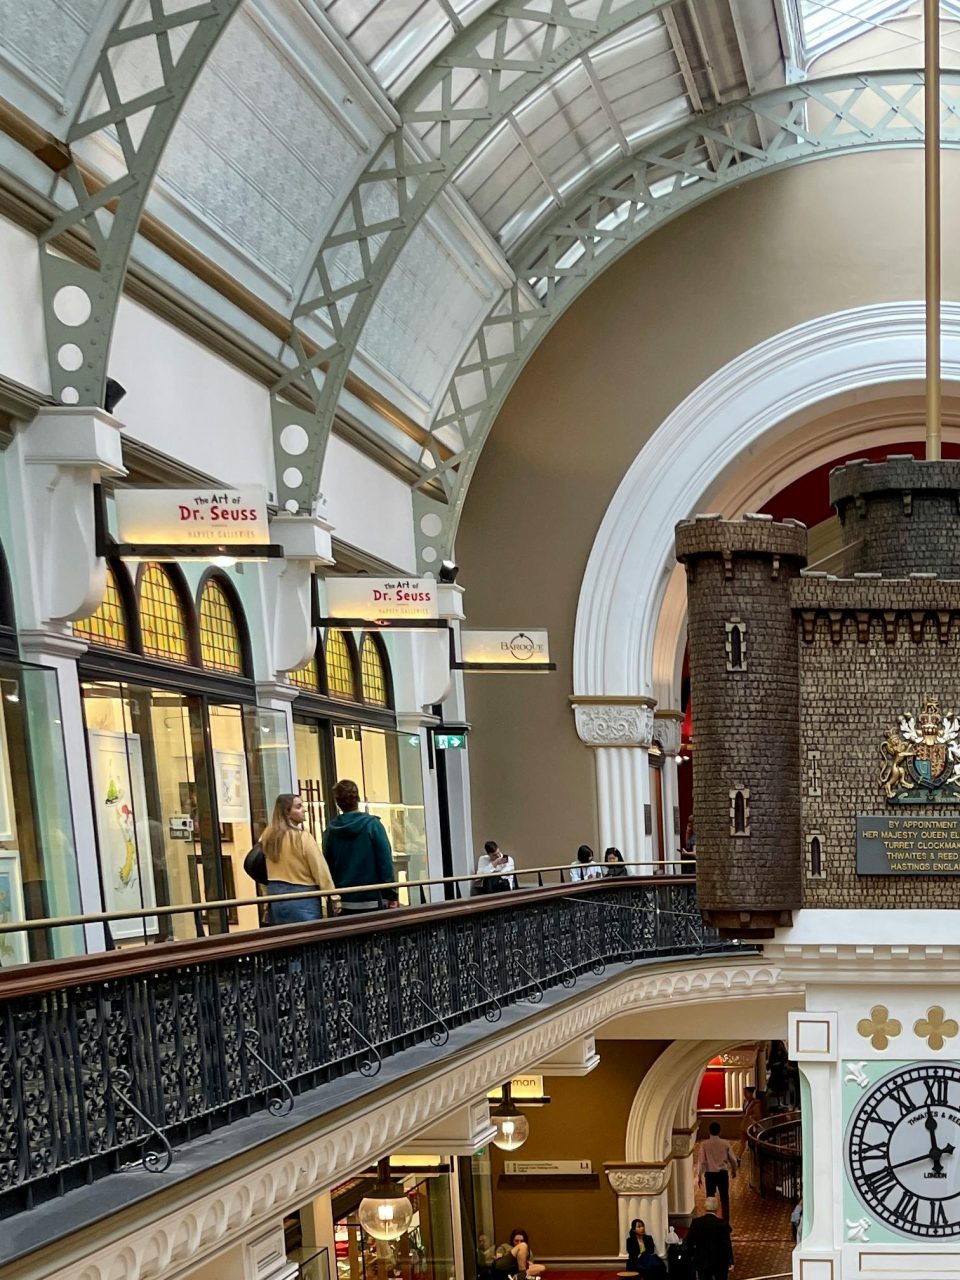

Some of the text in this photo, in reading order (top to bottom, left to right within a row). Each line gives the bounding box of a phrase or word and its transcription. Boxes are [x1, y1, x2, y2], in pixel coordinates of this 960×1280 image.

[193, 493, 242, 506] The Art of
[178, 505, 257, 521] Dr. Seuss
[396, 581, 410, 589] Art
[373, 590, 431, 601] Dr. Seuss
[500, 641, 544, 652] BAROQUE
[888, 821, 900, 829] BY
[902, 821, 957, 829] APPOINTMENT
[862, 831, 878, 839] HER
[881, 831, 918, 839] MAJESTY
[921, 831, 948, 839] QUEEN
[884, 841, 914, 849] TURRET
[886, 852, 927, 860] THWAITES
[930, 852, 935, 860] &
[937, 852, 959, 860] REED
[890, 863, 930, 871] HASTINGS
